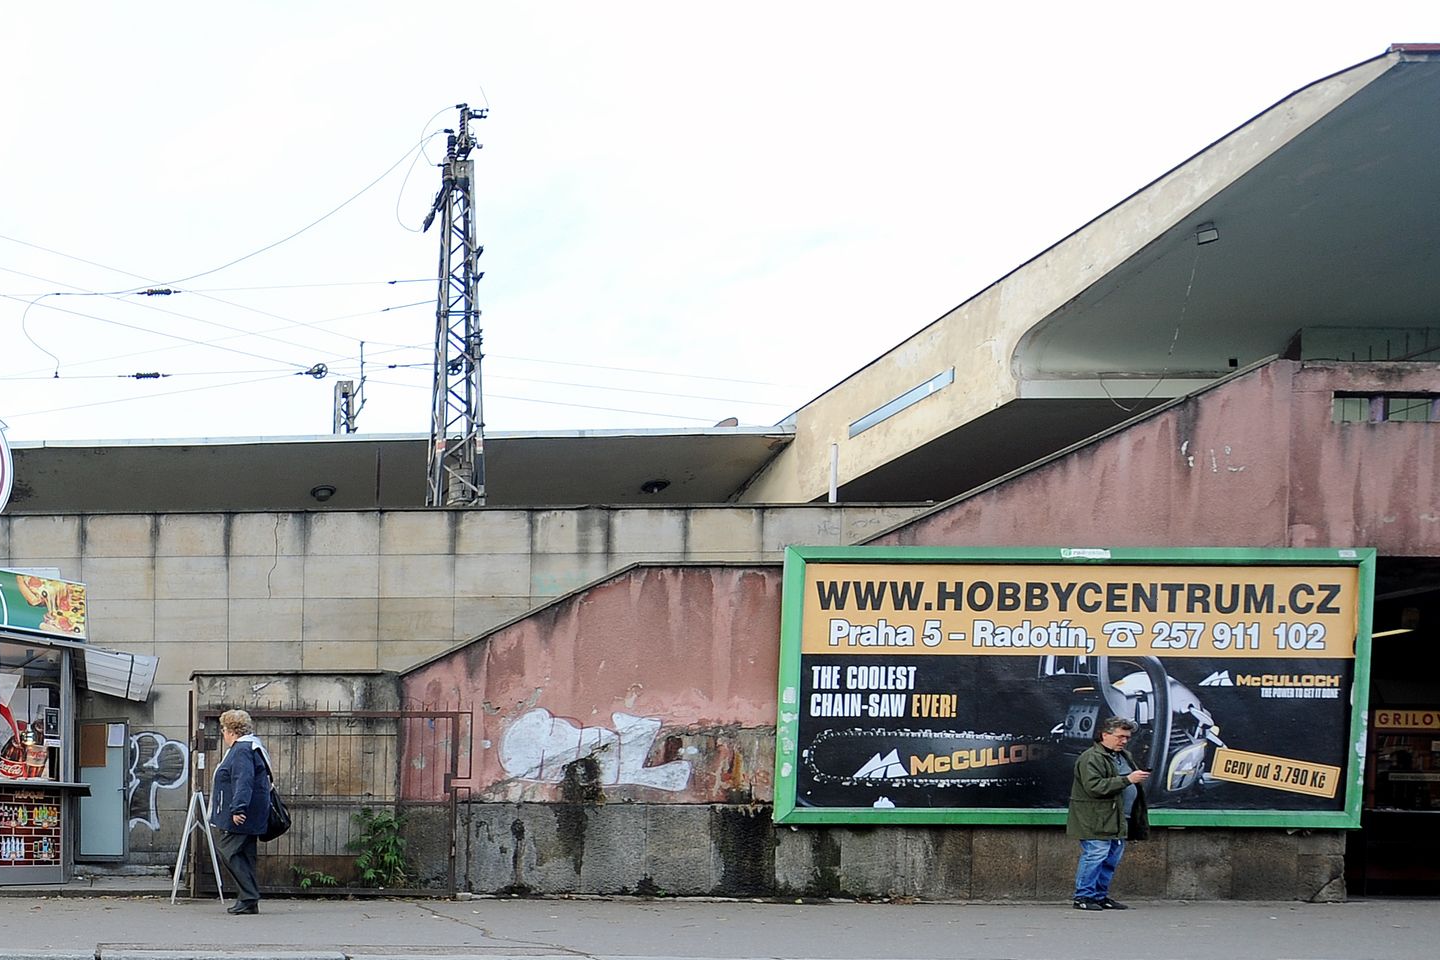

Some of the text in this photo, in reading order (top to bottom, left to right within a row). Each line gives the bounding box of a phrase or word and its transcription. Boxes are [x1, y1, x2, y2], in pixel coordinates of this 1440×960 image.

[816, 581, 1342, 614] WWW.HOBBYCENTRUM.CZ
[828, 618, 915, 647] Praha
[921, 619, 942, 647] 5
[972, 619, 1096, 653] Radotín,
[1150, 621, 1206, 650] 257
[1212, 622, 1260, 650] 911
[1274, 622, 1326, 650] 102
[811, 666, 917, 690] THE COOLEST
[1236, 674, 1339, 687] McCULLOCH
[810, 693, 957, 718] CHAIN-SAW EVER!
[1272, 688, 1295, 698] POWER
[1223, 759, 1327, 789] ceny od 3.790 Kč
